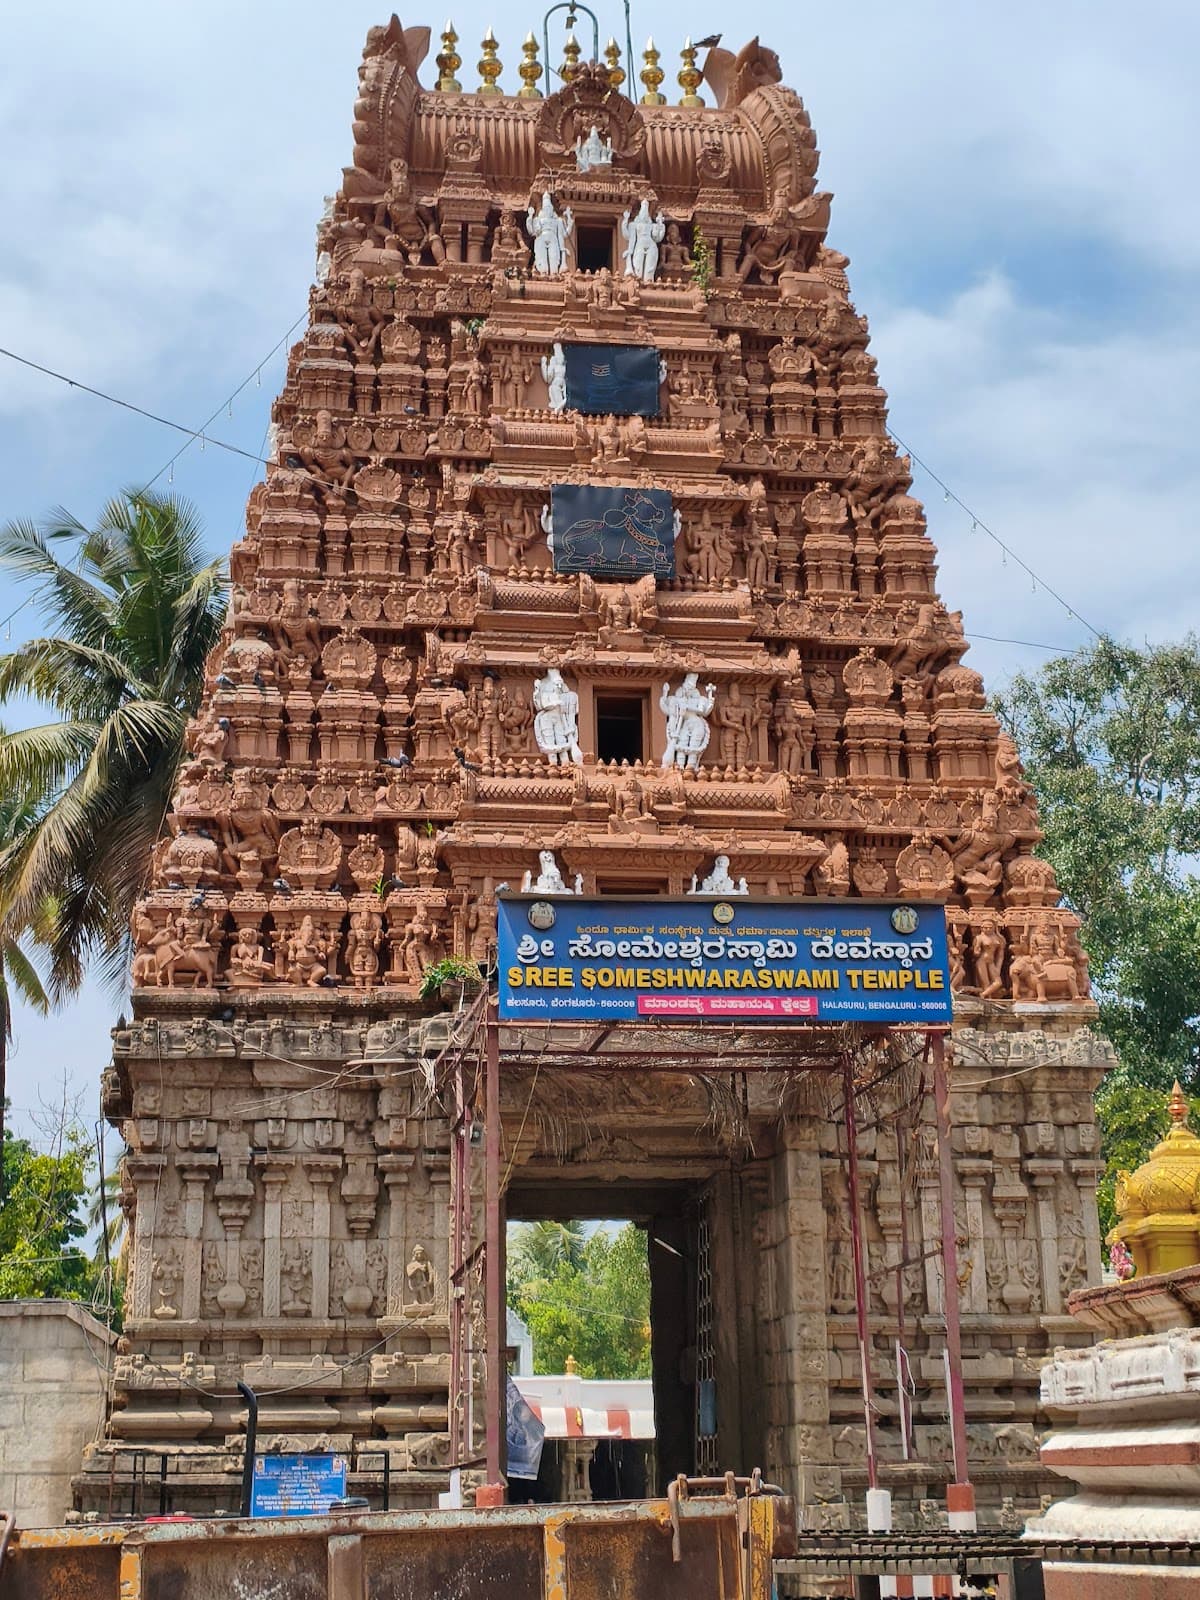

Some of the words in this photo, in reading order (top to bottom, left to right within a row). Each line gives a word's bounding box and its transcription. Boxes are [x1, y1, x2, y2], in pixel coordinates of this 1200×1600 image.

[516, 934, 555, 964] ಶ್ರೀ
[568, 934, 798, 968] ಸೋಮೇಶ್ವರಸ್ವಾಮಿ
[811, 936, 933, 969] ದೇವಸ್ಥಾನ
[507, 966, 574, 988] SREE
[581, 967, 840, 990] SOMESHWARASWAMI
[847, 969, 945, 990] TEMPLE
[822, 1001, 868, 1011] HALASURU,
